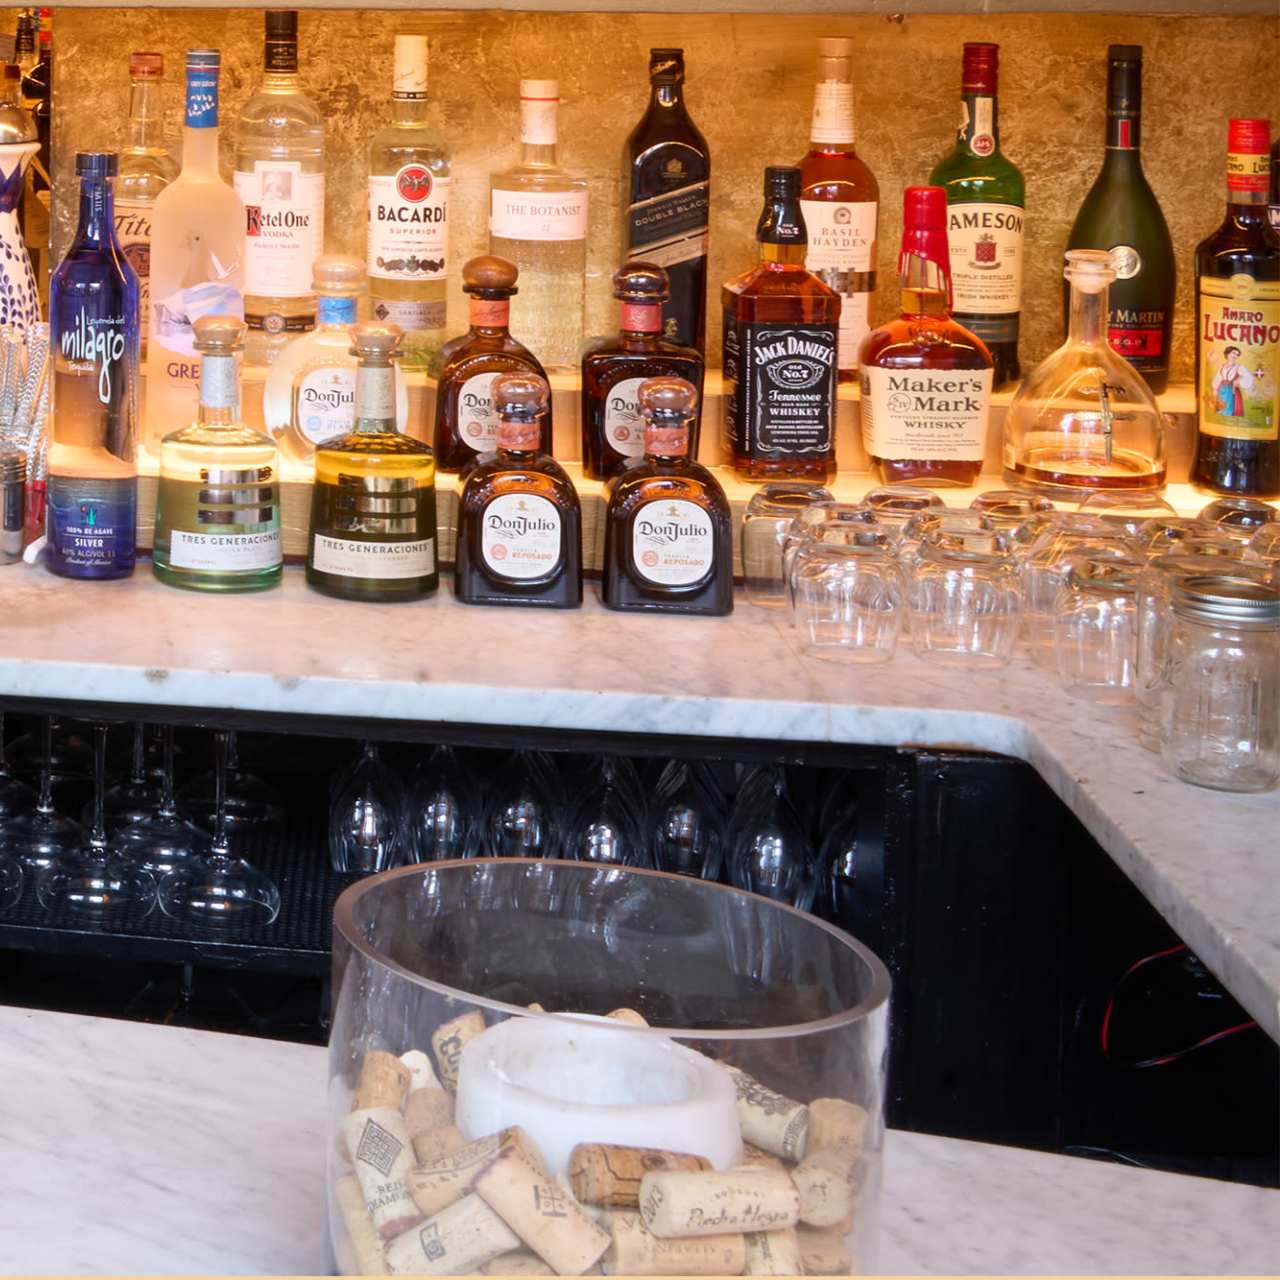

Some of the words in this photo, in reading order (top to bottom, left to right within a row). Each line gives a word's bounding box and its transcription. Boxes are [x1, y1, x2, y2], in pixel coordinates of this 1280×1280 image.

[246, 207, 282, 232] Ketel
[285, 211, 310, 228] One
[950, 212, 1023, 234] AMESON
[822, 227, 861, 237] BASIL
[813, 237, 867, 248] HAYDEN
[61, 305, 125, 404] milagro
[754, 339, 787, 365] JACK
[167, 362, 200, 380] GRE
[887, 376, 982, 393] Maker's
[768, 389, 823, 402] Tennessee
[769, 407, 821, 416] WHISKEY
[912, 396, 980, 412] Mark
[904, 420, 966, 430] WHISKY
[75, 538, 104, 548] SILVER
[181, 533, 207, 546] TRES
[322, 539, 344, 552] TRES
[348, 542, 428, 555] GENERACIONES
